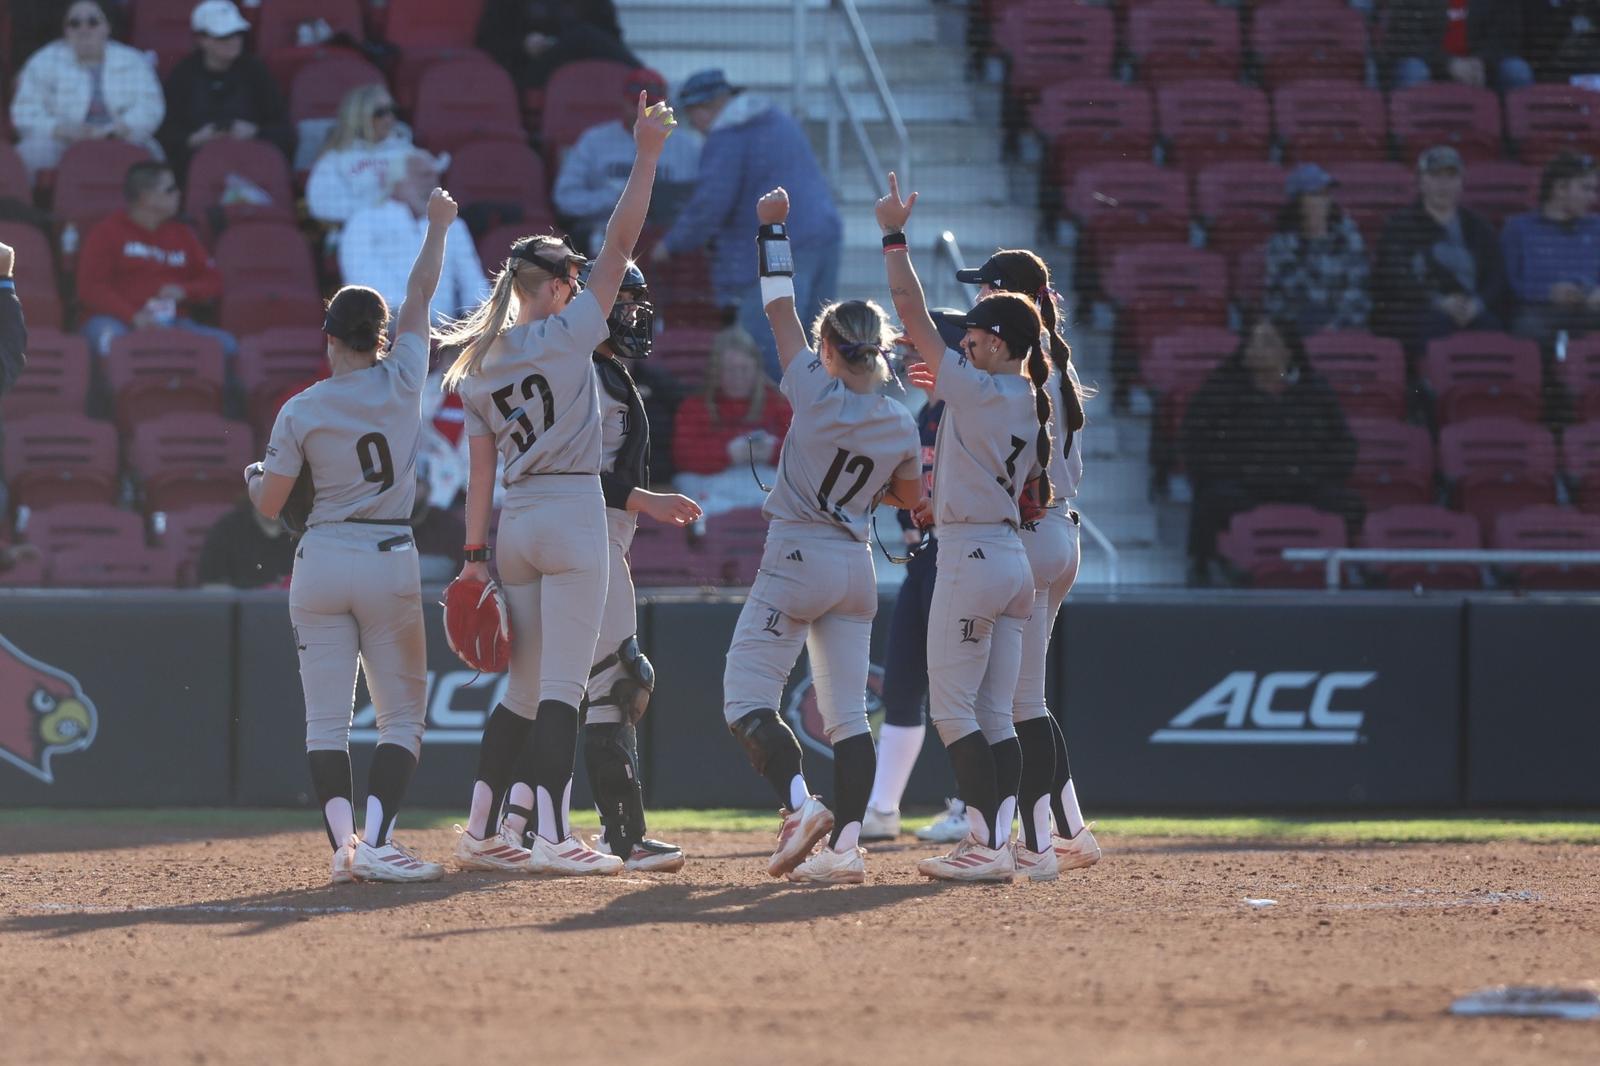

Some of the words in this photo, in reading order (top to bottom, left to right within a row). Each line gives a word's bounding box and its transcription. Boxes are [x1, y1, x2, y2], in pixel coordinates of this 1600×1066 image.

[491, 373, 555, 453] 52
[356, 431, 395, 495] 9
[817, 447, 875, 524] 12
[762, 607, 785, 638] L
[958, 617, 980, 644] L
[1168, 670, 1378, 728] ACC
